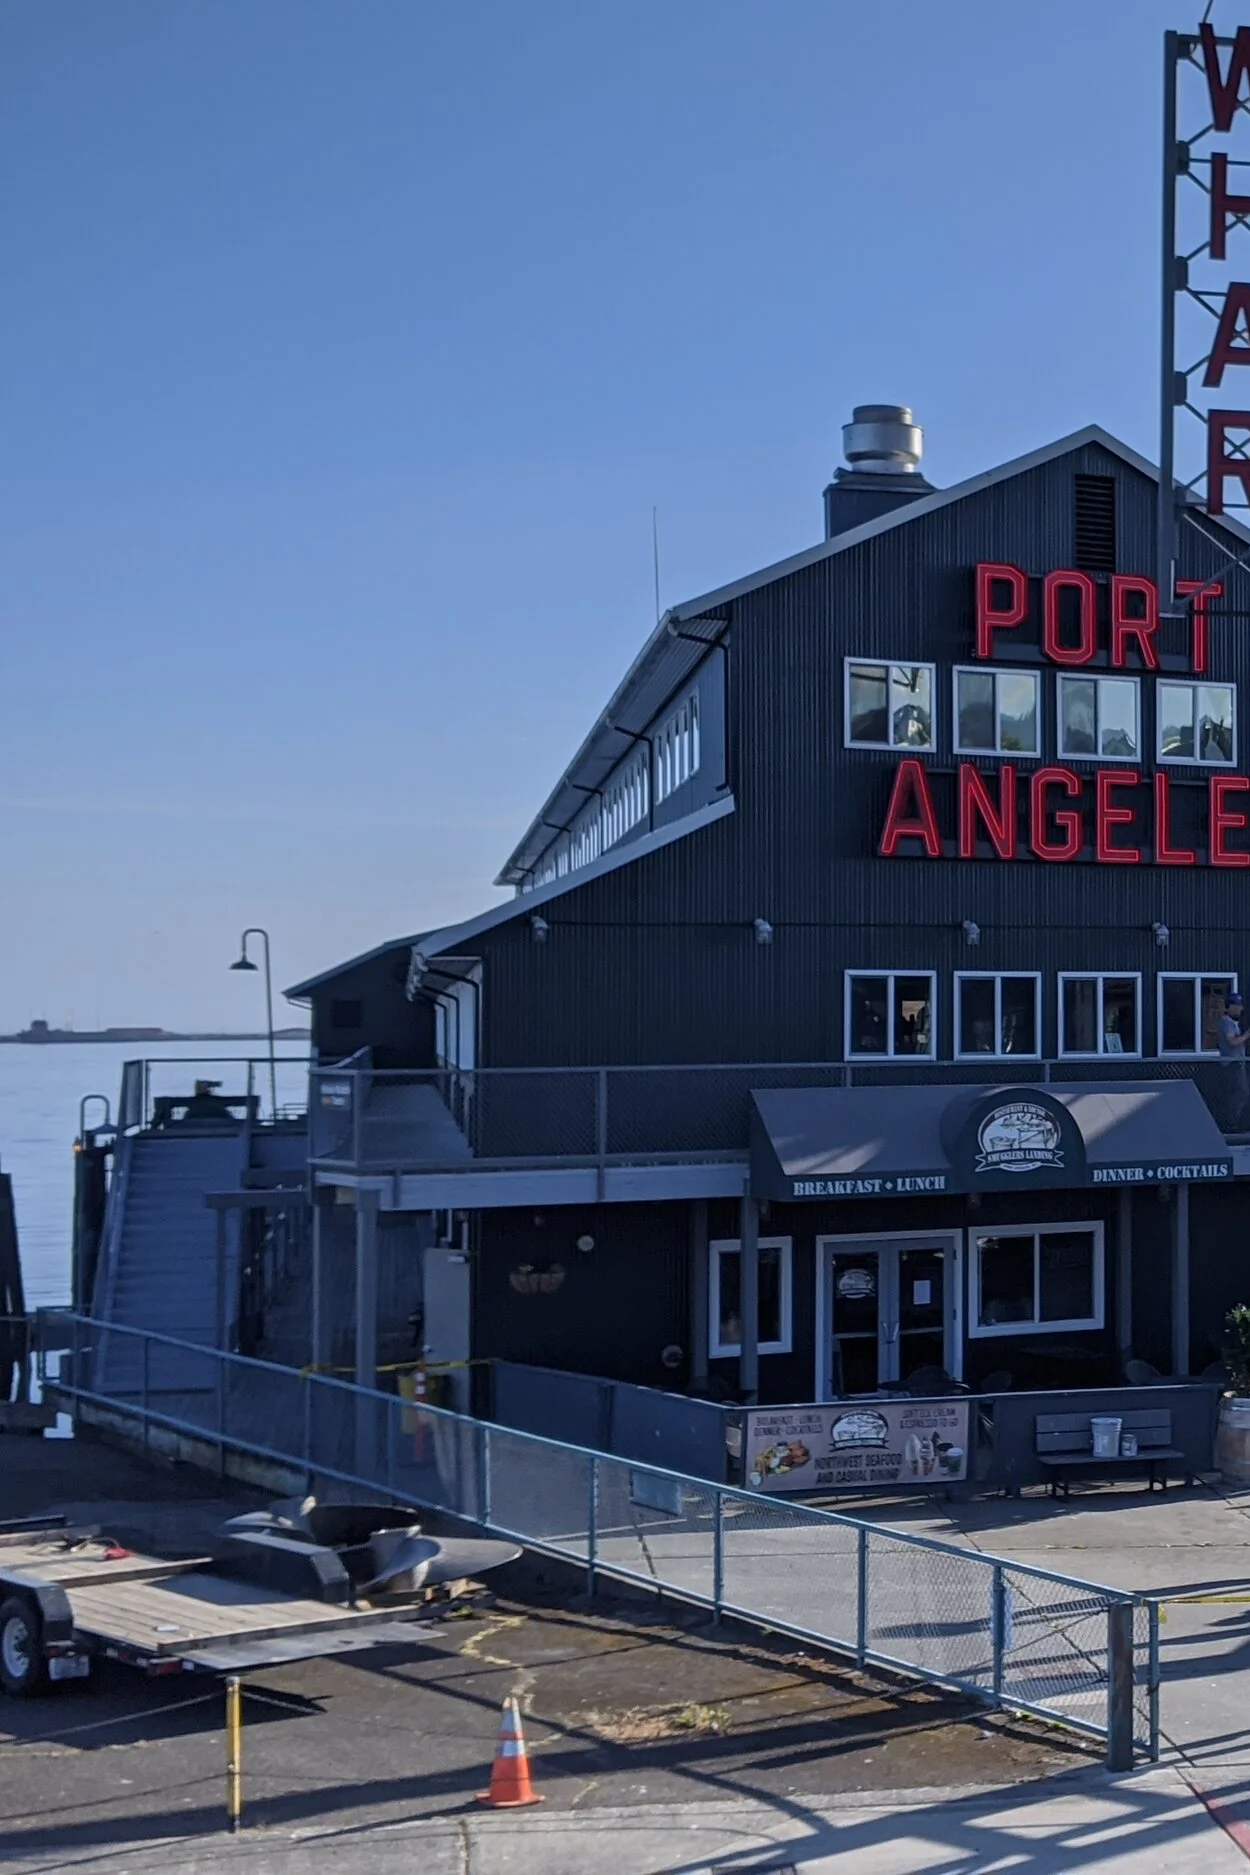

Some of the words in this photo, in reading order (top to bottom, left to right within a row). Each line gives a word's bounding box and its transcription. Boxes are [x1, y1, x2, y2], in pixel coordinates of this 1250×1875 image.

[974, 561, 1225, 675] PORT
[987, 1150, 1025, 1163] SMUGGLERS
[1025, 1150, 1054, 1161] LANDING
[1092, 1167, 1144, 1183] DINNER
[1157, 1164, 1228, 1180] COCKTAILS
[793, 1179, 883, 1196] BREAKFAST
[897, 1176, 946, 1192] LUNCH
[814, 1455, 863, 1471] NORTHWEST
[865, 1453, 902, 1468] SEAFOOD
